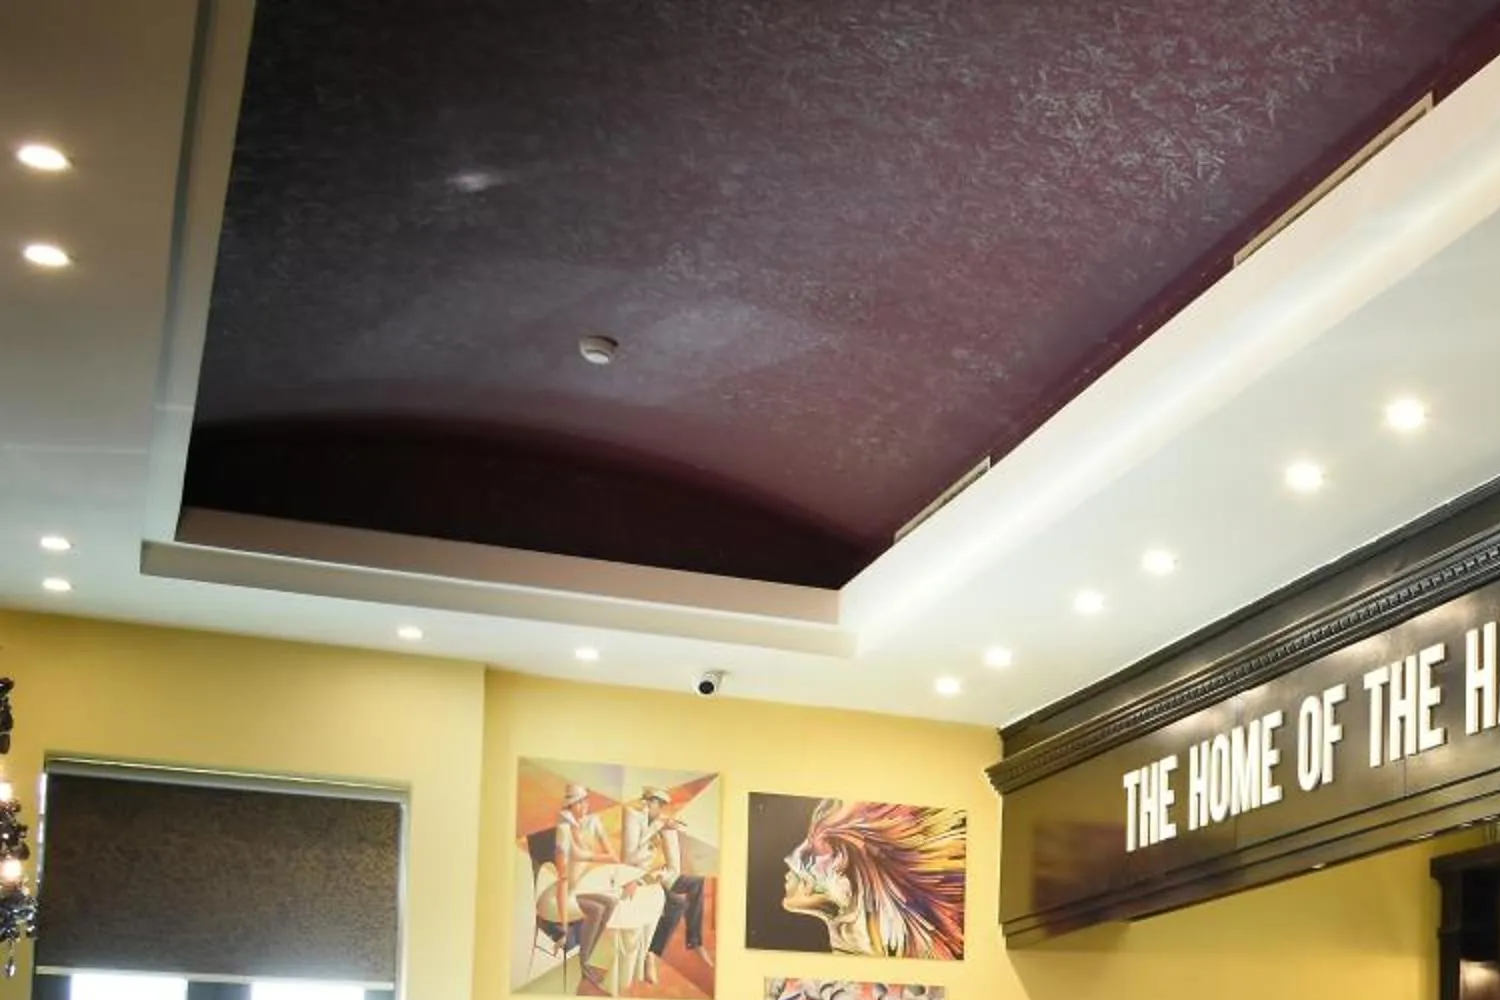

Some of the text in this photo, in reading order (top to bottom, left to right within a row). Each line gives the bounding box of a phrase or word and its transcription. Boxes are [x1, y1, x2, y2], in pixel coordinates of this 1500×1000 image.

[1123, 769, 1179, 853] THE
[1188, 709, 1283, 831] HOME
[1297, 684, 1347, 792] OF
[1363, 642, 1447, 768] THE
